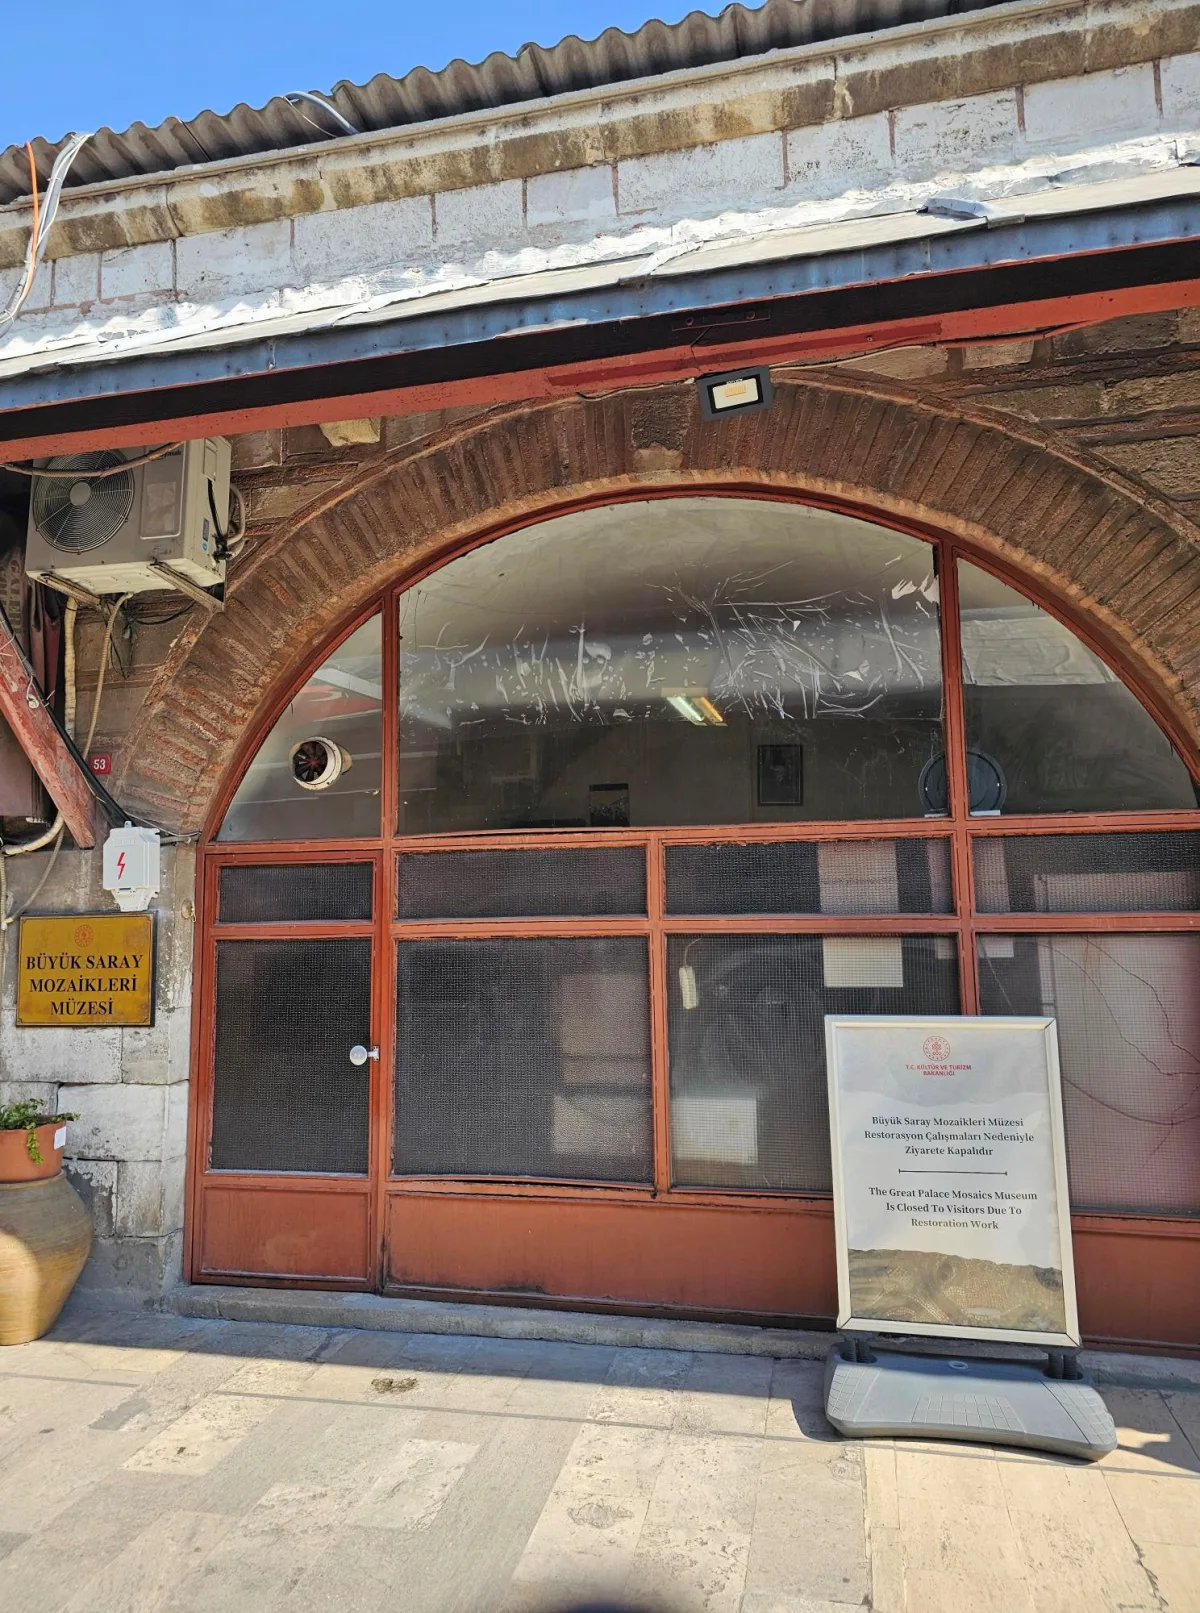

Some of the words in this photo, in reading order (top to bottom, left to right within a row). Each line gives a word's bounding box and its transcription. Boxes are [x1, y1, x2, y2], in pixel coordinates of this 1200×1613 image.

[94, 759, 105, 770] 53
[26, 952, 82, 970] BÜYÜK
[85, 955, 143, 969] SARAY
[29, 974, 137, 992] MOZAİKLERİ
[51, 997, 114, 1015] MÜZESİ
[872, 1116, 902, 1126] Büyük
[904, 1117, 931, 1127] Saray
[933, 1117, 986, 1126] Mozaikleri
[988, 1118, 1024, 1126] Müzesi
[864, 1131, 924, 1141] Restorasyon
[925, 1131, 981, 1142] Çalışmaları
[983, 1132, 1035, 1143] Nedeniyle
[905, 1146, 945, 1156] Ziyarete
[947, 1147, 993, 1157] Kapalıdır
[868, 1187, 887, 1196] The
[889, 1188, 915, 1197] Great
[918, 1189, 950, 1198] Palace
[952, 1190, 992, 1199] Mosaics
[994, 1191, 1038, 1200] Museum
[886, 1202, 895, 1211] Is
[896, 1203, 930, 1212] Closed
[931, 1204, 945, 1213] To
[946, 1204, 985, 1214] Visitors
[987, 1206, 1007, 1214] Due
[1008, 1206, 1022, 1214] To
[911, 1218, 968, 1228] Restoration
[970, 1220, 999, 1229] Work
